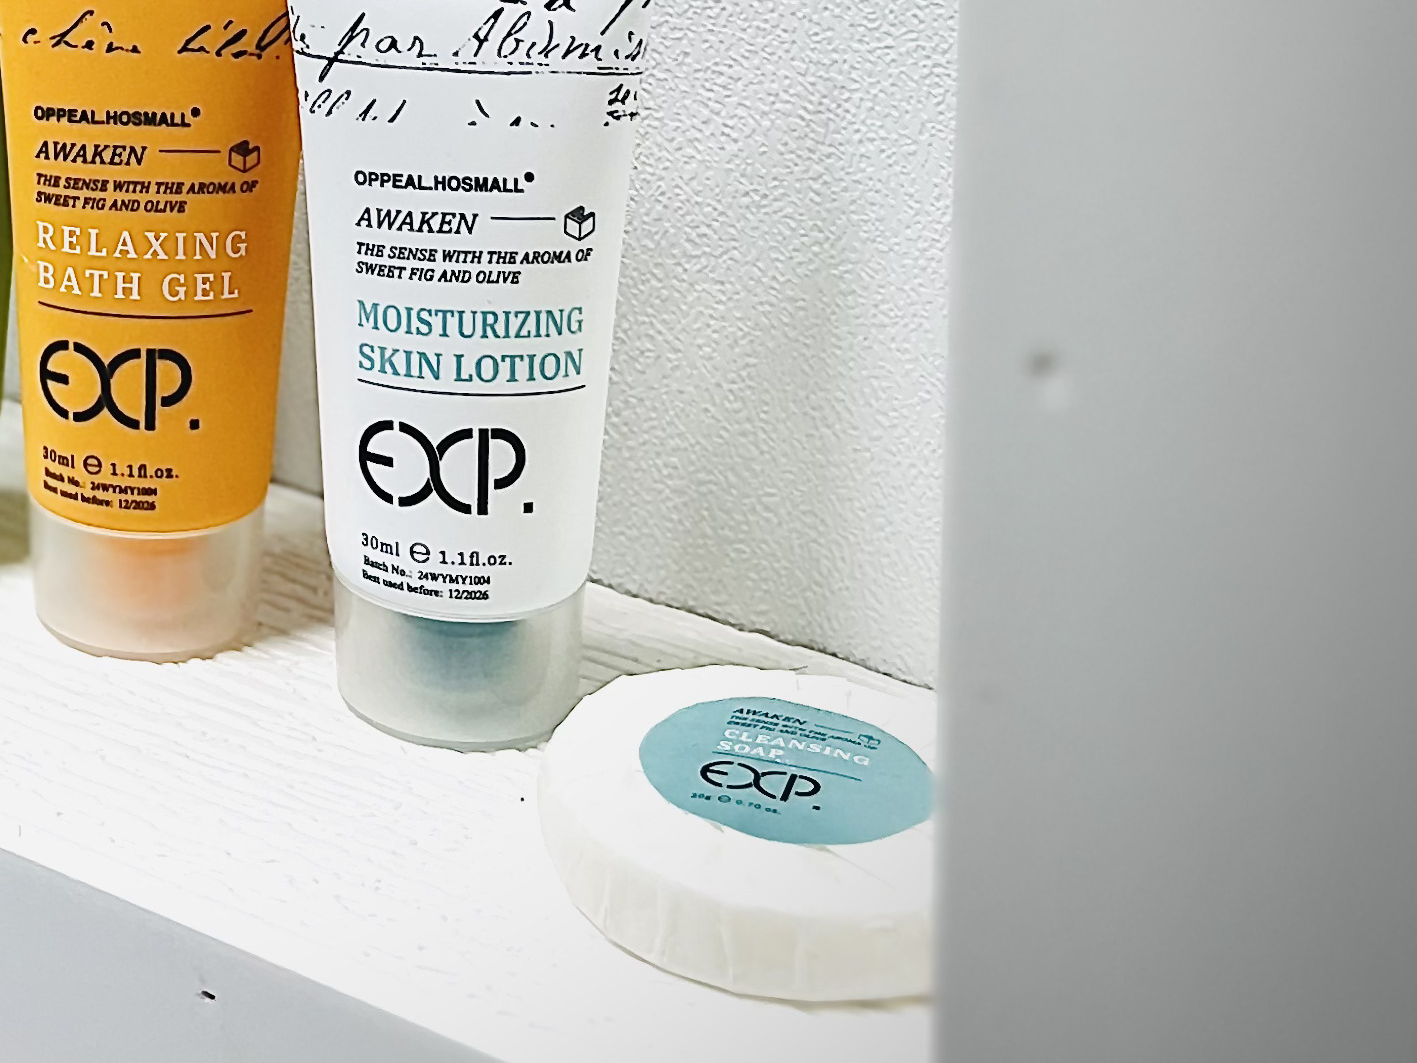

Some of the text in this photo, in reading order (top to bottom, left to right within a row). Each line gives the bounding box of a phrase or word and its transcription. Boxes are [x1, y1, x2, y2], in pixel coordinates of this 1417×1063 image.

[318, 12, 437, 82] par
[34, 140, 148, 166] AWAKEN
[36, 172, 259, 195] THE SENSE WITH THE AROMA OF
[36, 191, 188, 214] SWEET FIG AND OLIVE
[355, 206, 479, 235] AWAKEN
[36, 220, 249, 260] RELAXING
[356, 241, 594, 265] THE SENSE WITH THE AROMA OF
[38, 260, 240, 302] BATH GEL
[355, 261, 522, 285] SWEET FIG AND OLIVE
[357, 299, 584, 339] MOISTURIZING
[358, 342, 584, 383] SKIN LOTION
[43, 445, 75, 469] 30ml
[361, 532, 400, 557] 30ml
[407, 582, 444, 598] before:
[448, 588, 490, 601] 12/2026
[733, 707, 808, 726] AWAKEN
[717, 740, 785, 759] SOAP
[724, 729, 871, 766] CLEANSING
